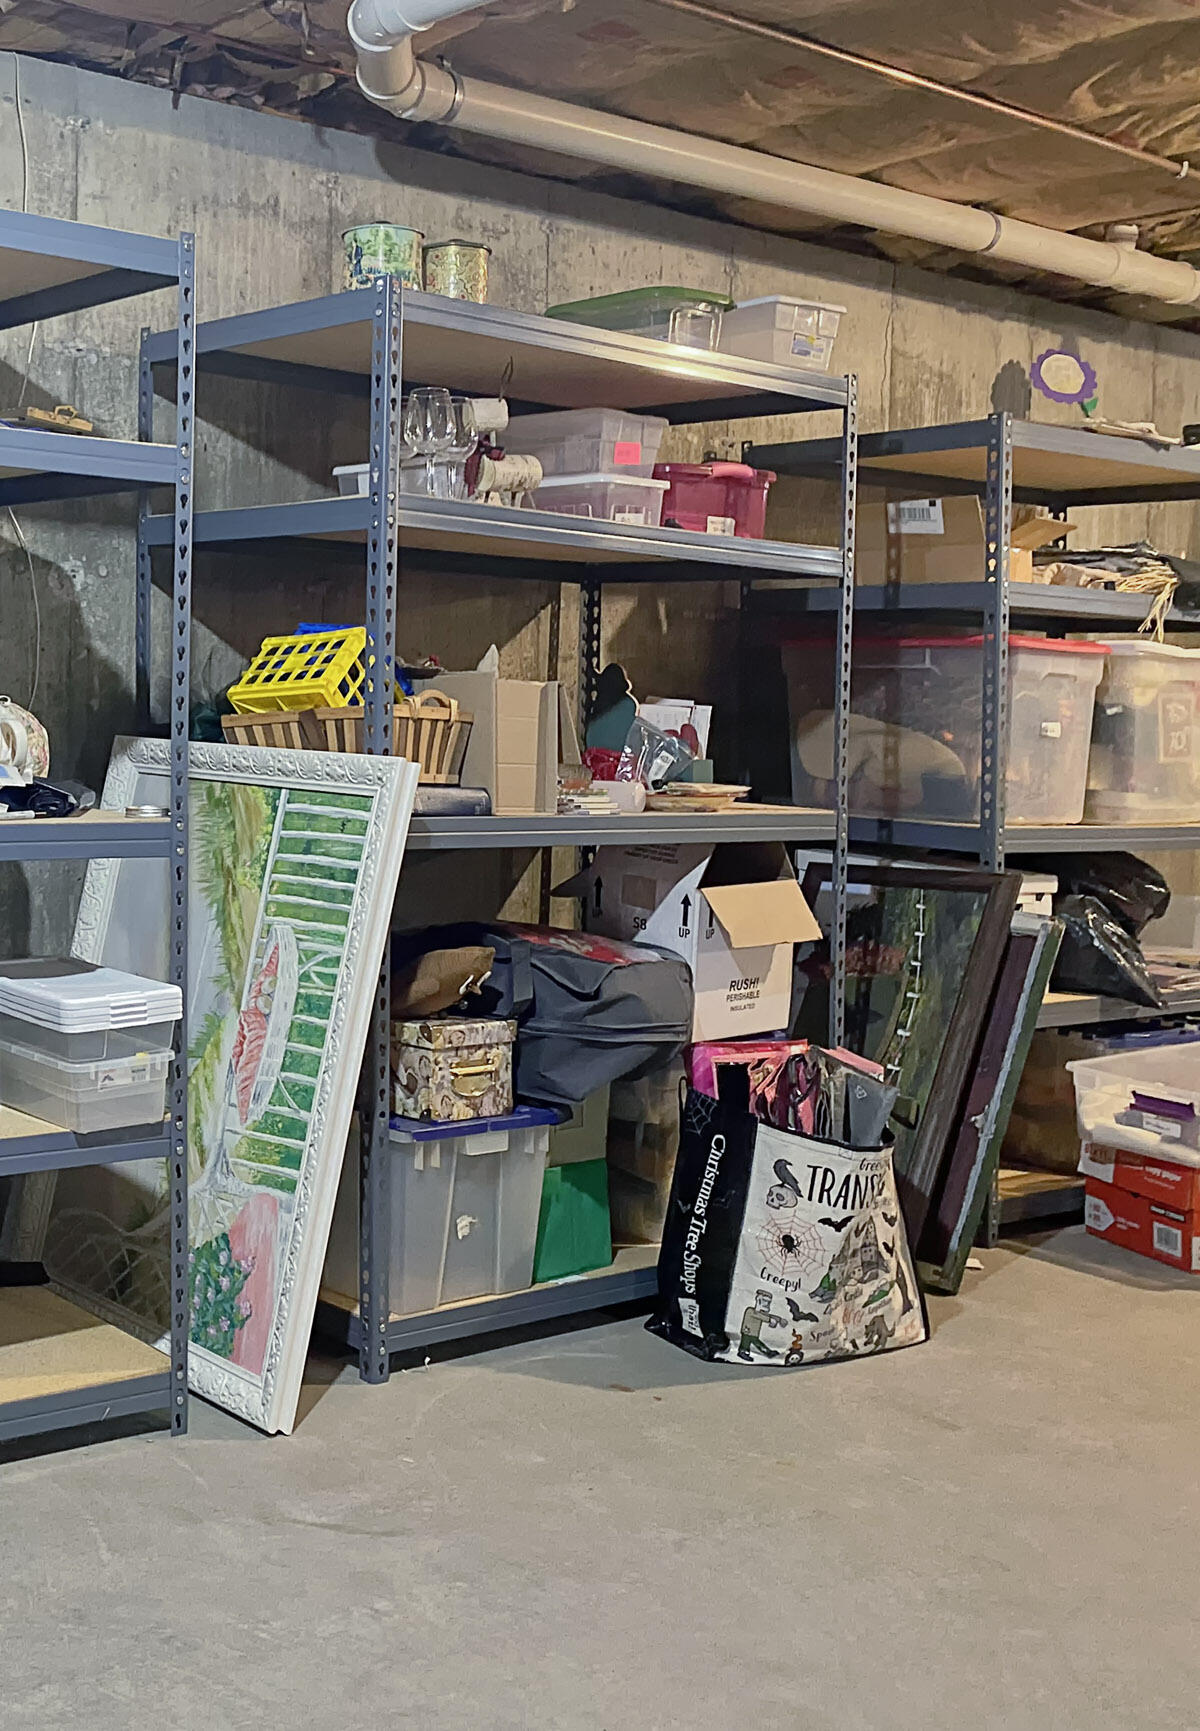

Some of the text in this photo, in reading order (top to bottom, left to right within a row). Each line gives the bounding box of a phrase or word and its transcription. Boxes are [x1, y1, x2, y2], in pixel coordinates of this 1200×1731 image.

[678, 926, 691, 939] UP
[705, 928, 715, 940] UP
[729, 977, 760, 992] RUSH!
[726, 990, 760, 1002] PERISHABLE
[679, 1134, 726, 1294] Christmas Tree Shops
